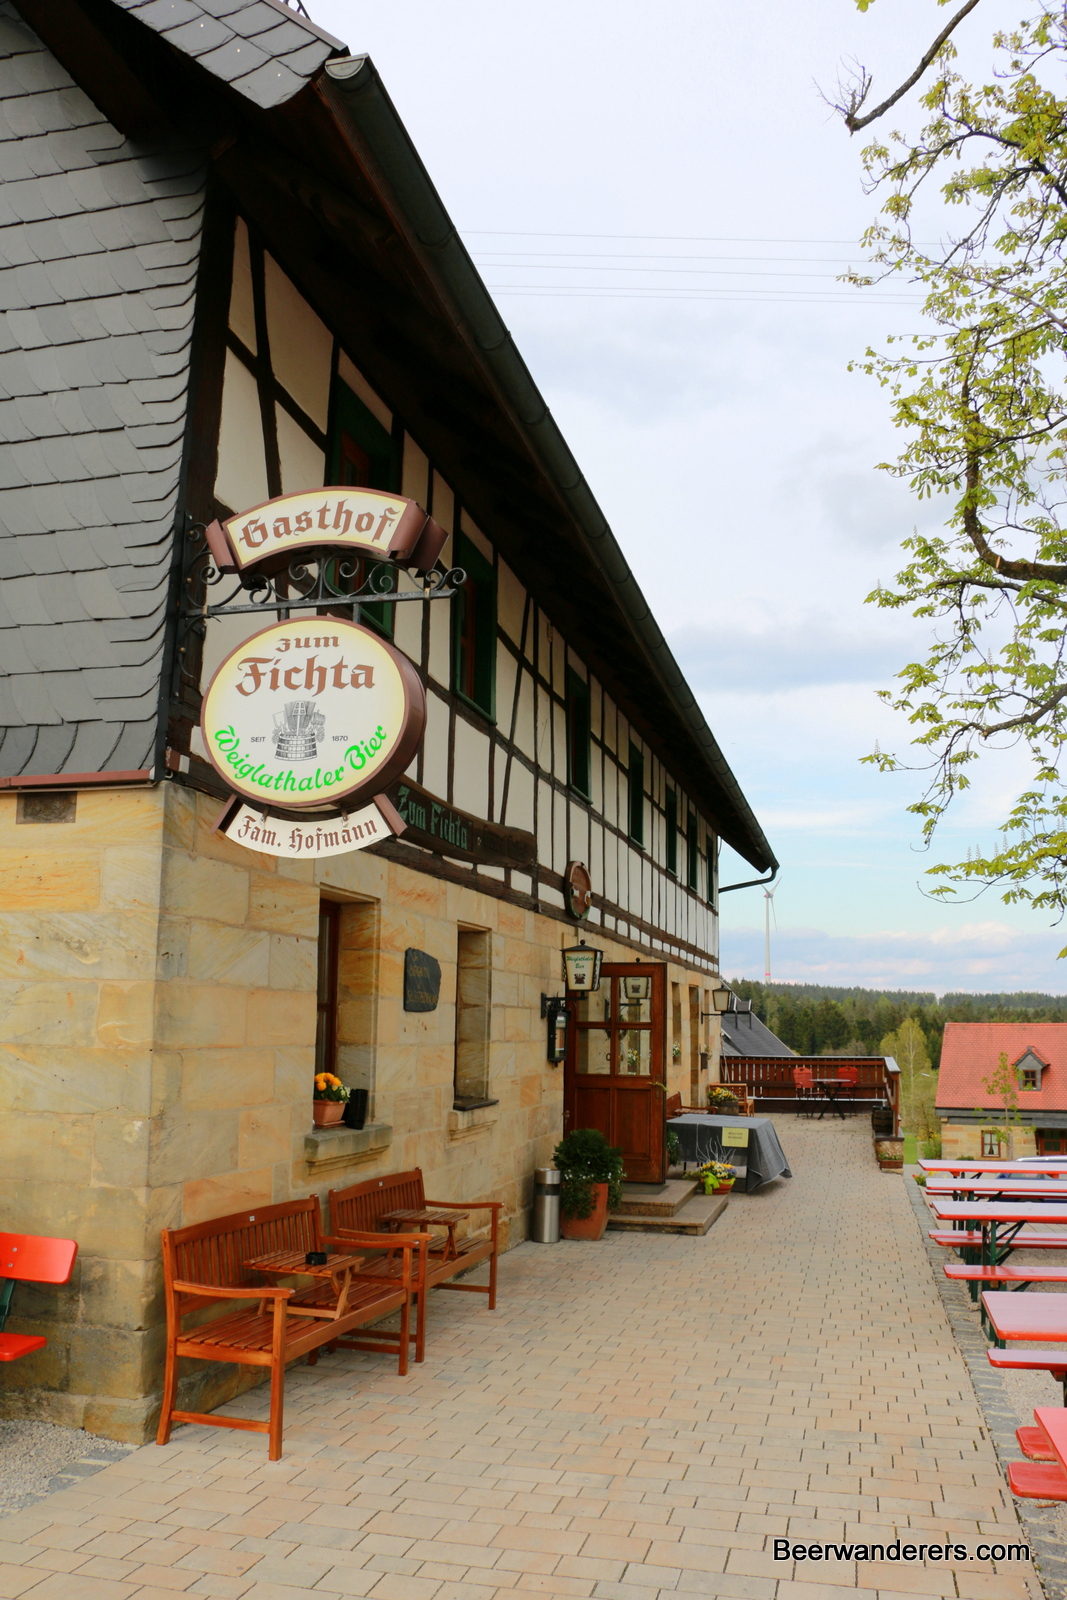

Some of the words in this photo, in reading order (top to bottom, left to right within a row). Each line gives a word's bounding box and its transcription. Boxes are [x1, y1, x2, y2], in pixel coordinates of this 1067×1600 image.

[239, 499, 400, 548] Gasthof
[276, 635, 340, 653] zum
[235, 654, 376, 697] Fichta
[214, 725, 345, 791] Weiglathaler
[344, 725, 387, 770] Bier
[238, 815, 281, 848] Fam.
[288, 819, 378, 854] Hofmann
